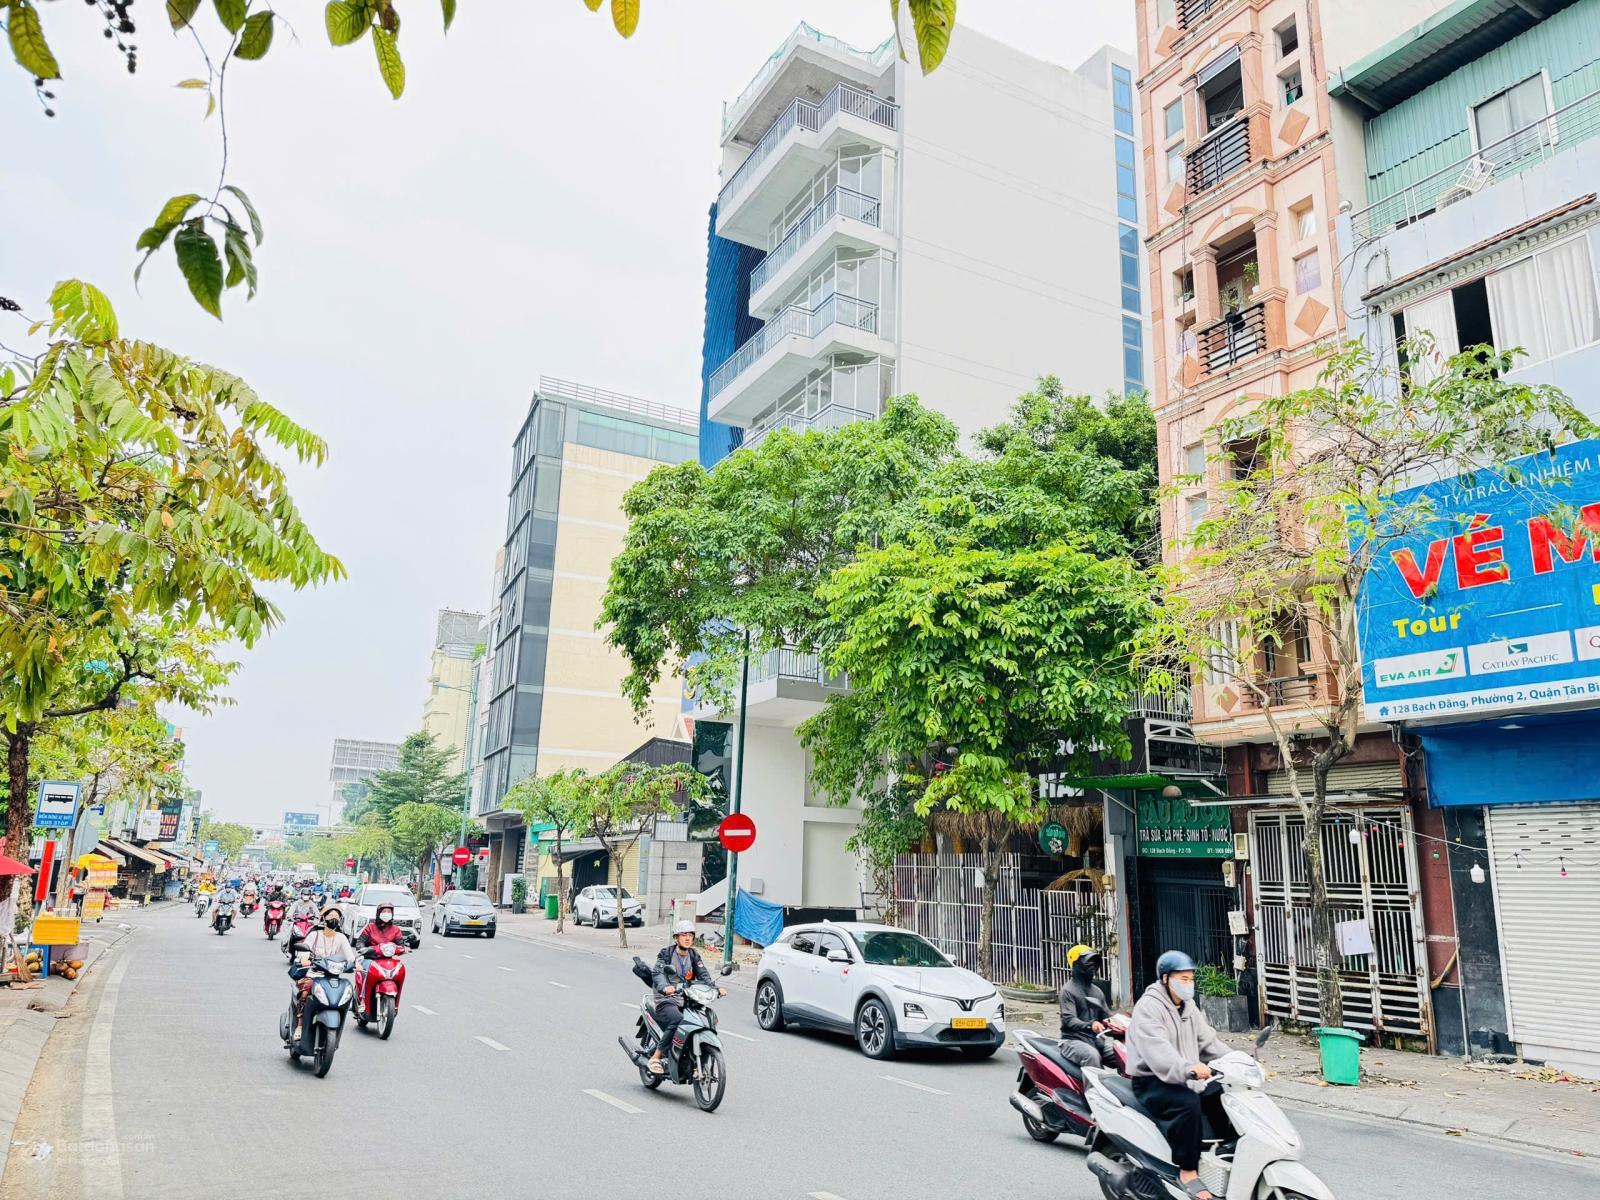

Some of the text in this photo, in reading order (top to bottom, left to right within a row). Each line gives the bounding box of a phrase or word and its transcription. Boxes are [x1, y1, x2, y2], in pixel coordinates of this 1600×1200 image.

[1391, 513, 1510, 599] VÉ
[1393, 613, 1462, 638] Tour
[1380, 668, 1431, 682] EVA AIR
[1393, 704, 1410, 714] 128
[1412, 701, 1436, 714] Bạch
[1516, 691, 1527, 701] 2,
[1529, 687, 1561, 700] Quận
